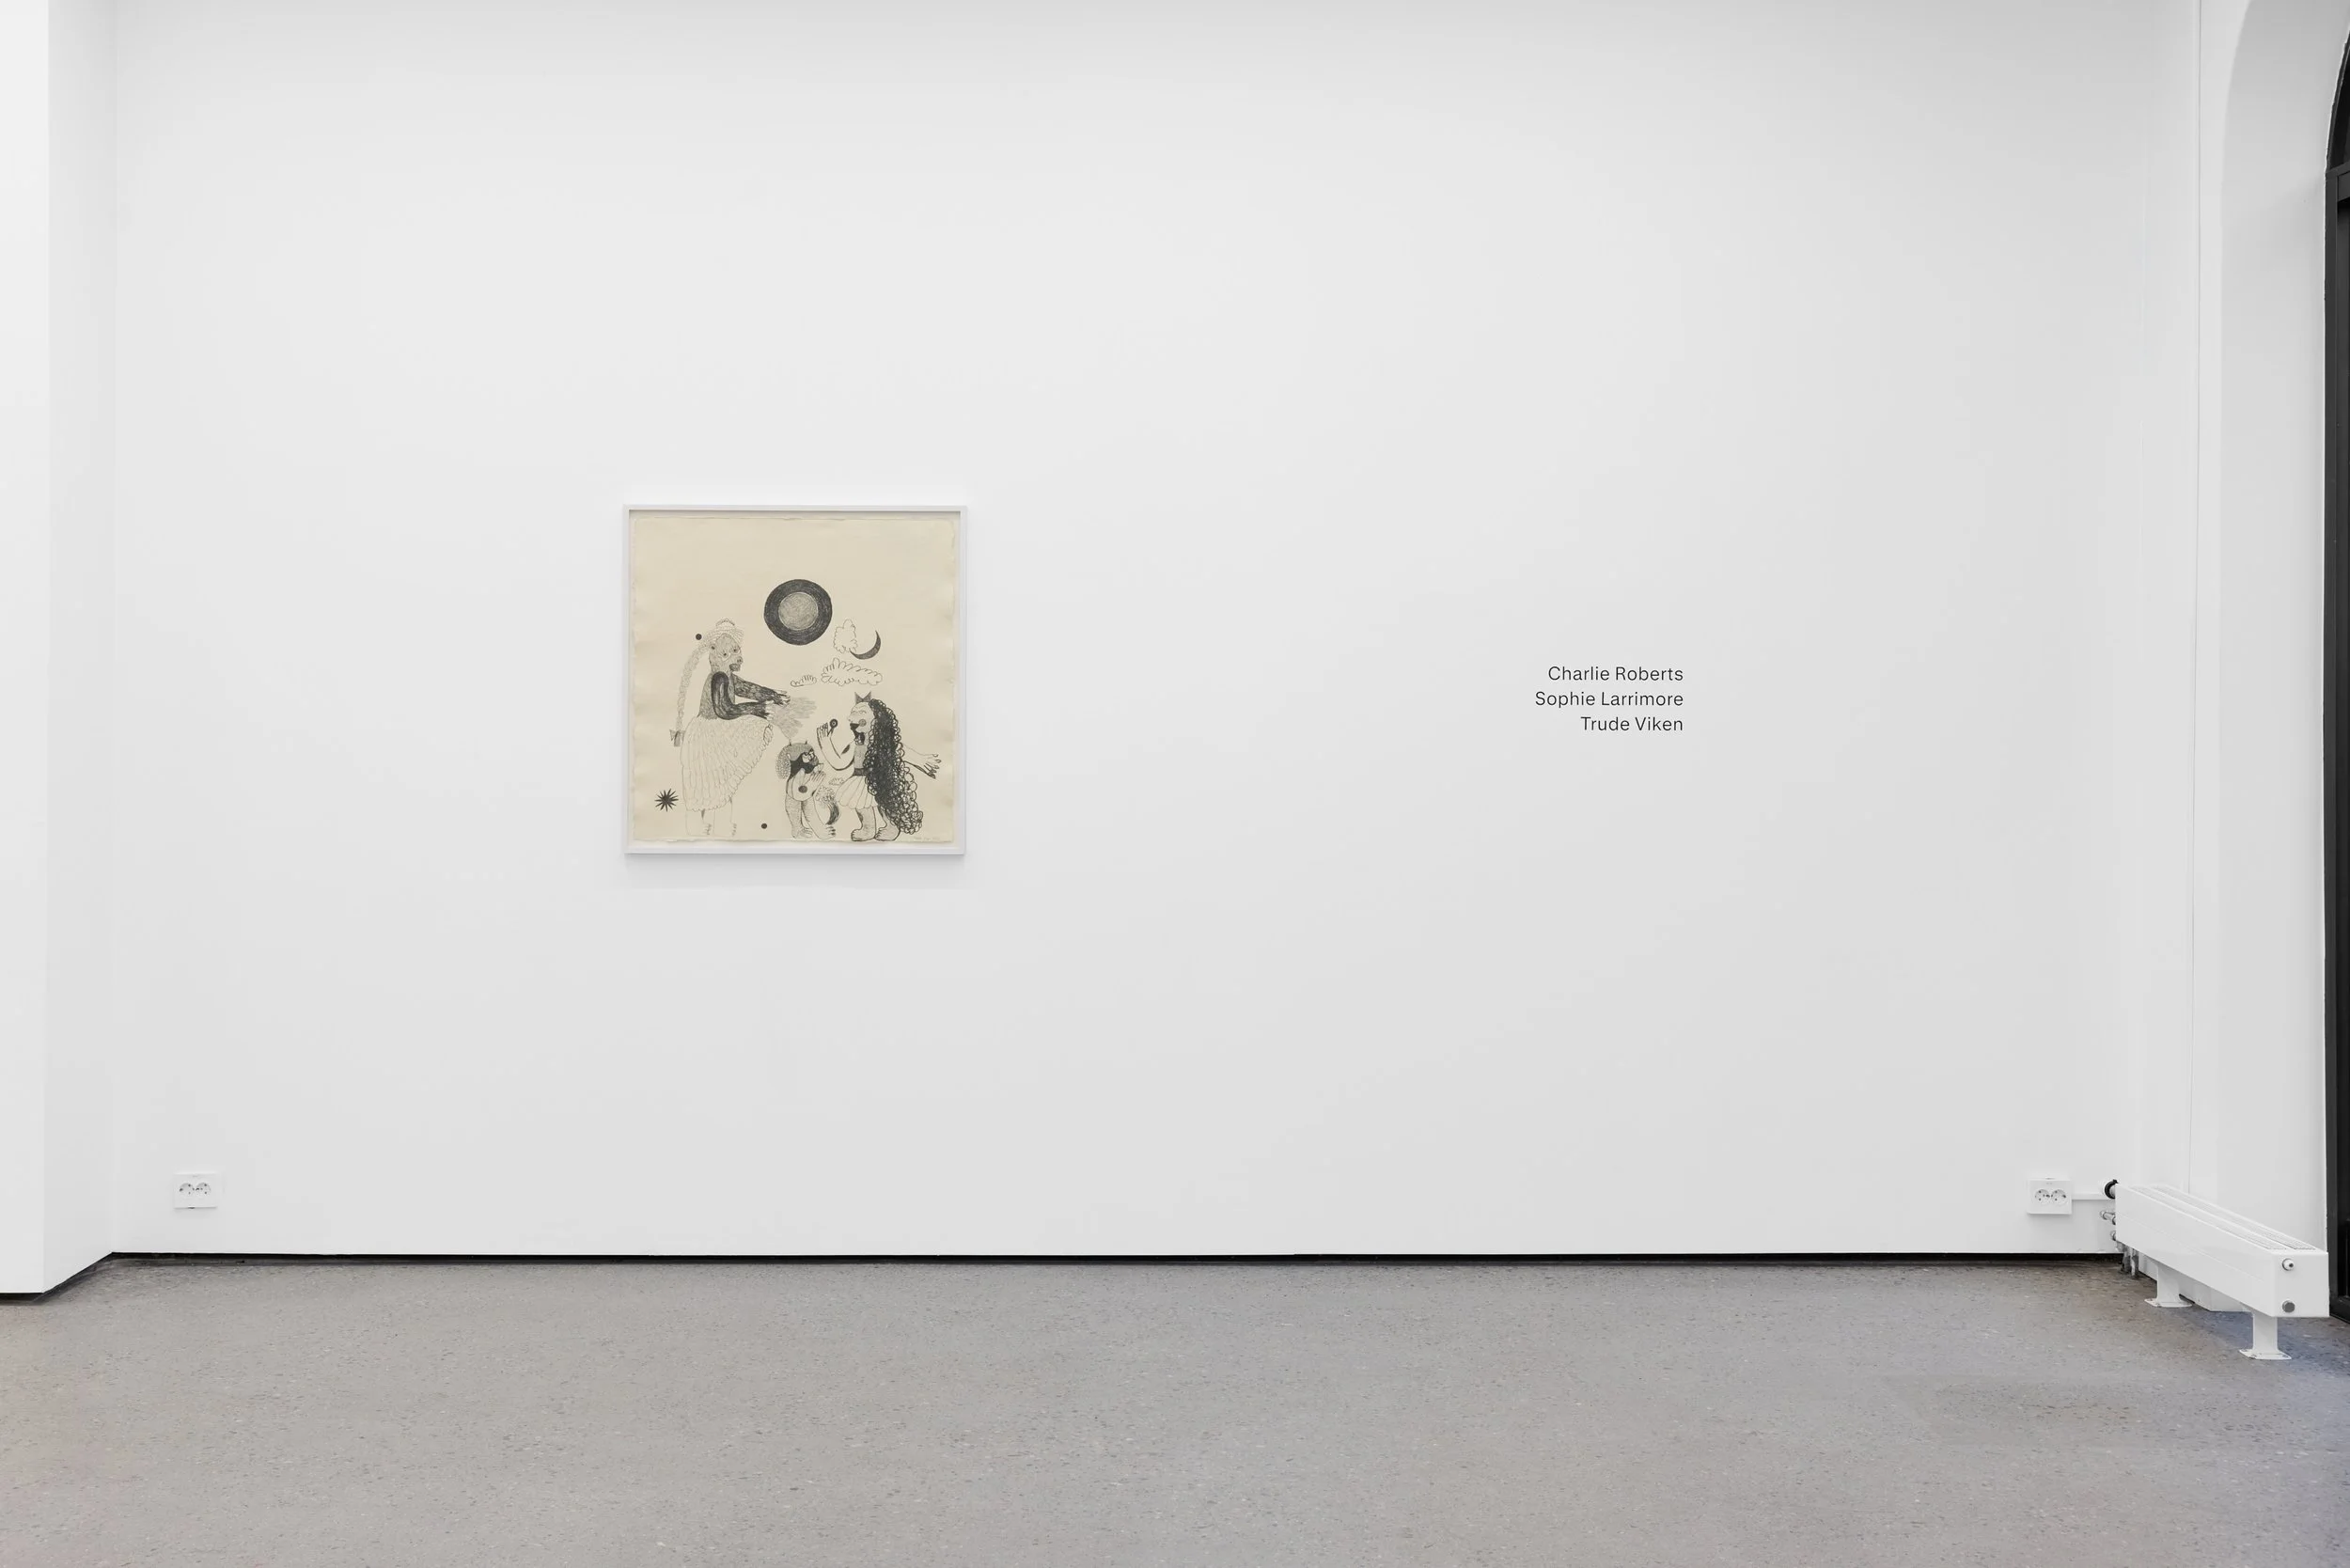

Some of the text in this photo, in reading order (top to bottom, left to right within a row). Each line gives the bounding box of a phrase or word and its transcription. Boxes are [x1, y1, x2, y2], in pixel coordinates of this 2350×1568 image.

[1547, 666, 1684, 681] Charlie Roberts
[1535, 691, 1684, 709] Sophie Larrimore
[1580, 716, 1684, 731] Trude Viken
